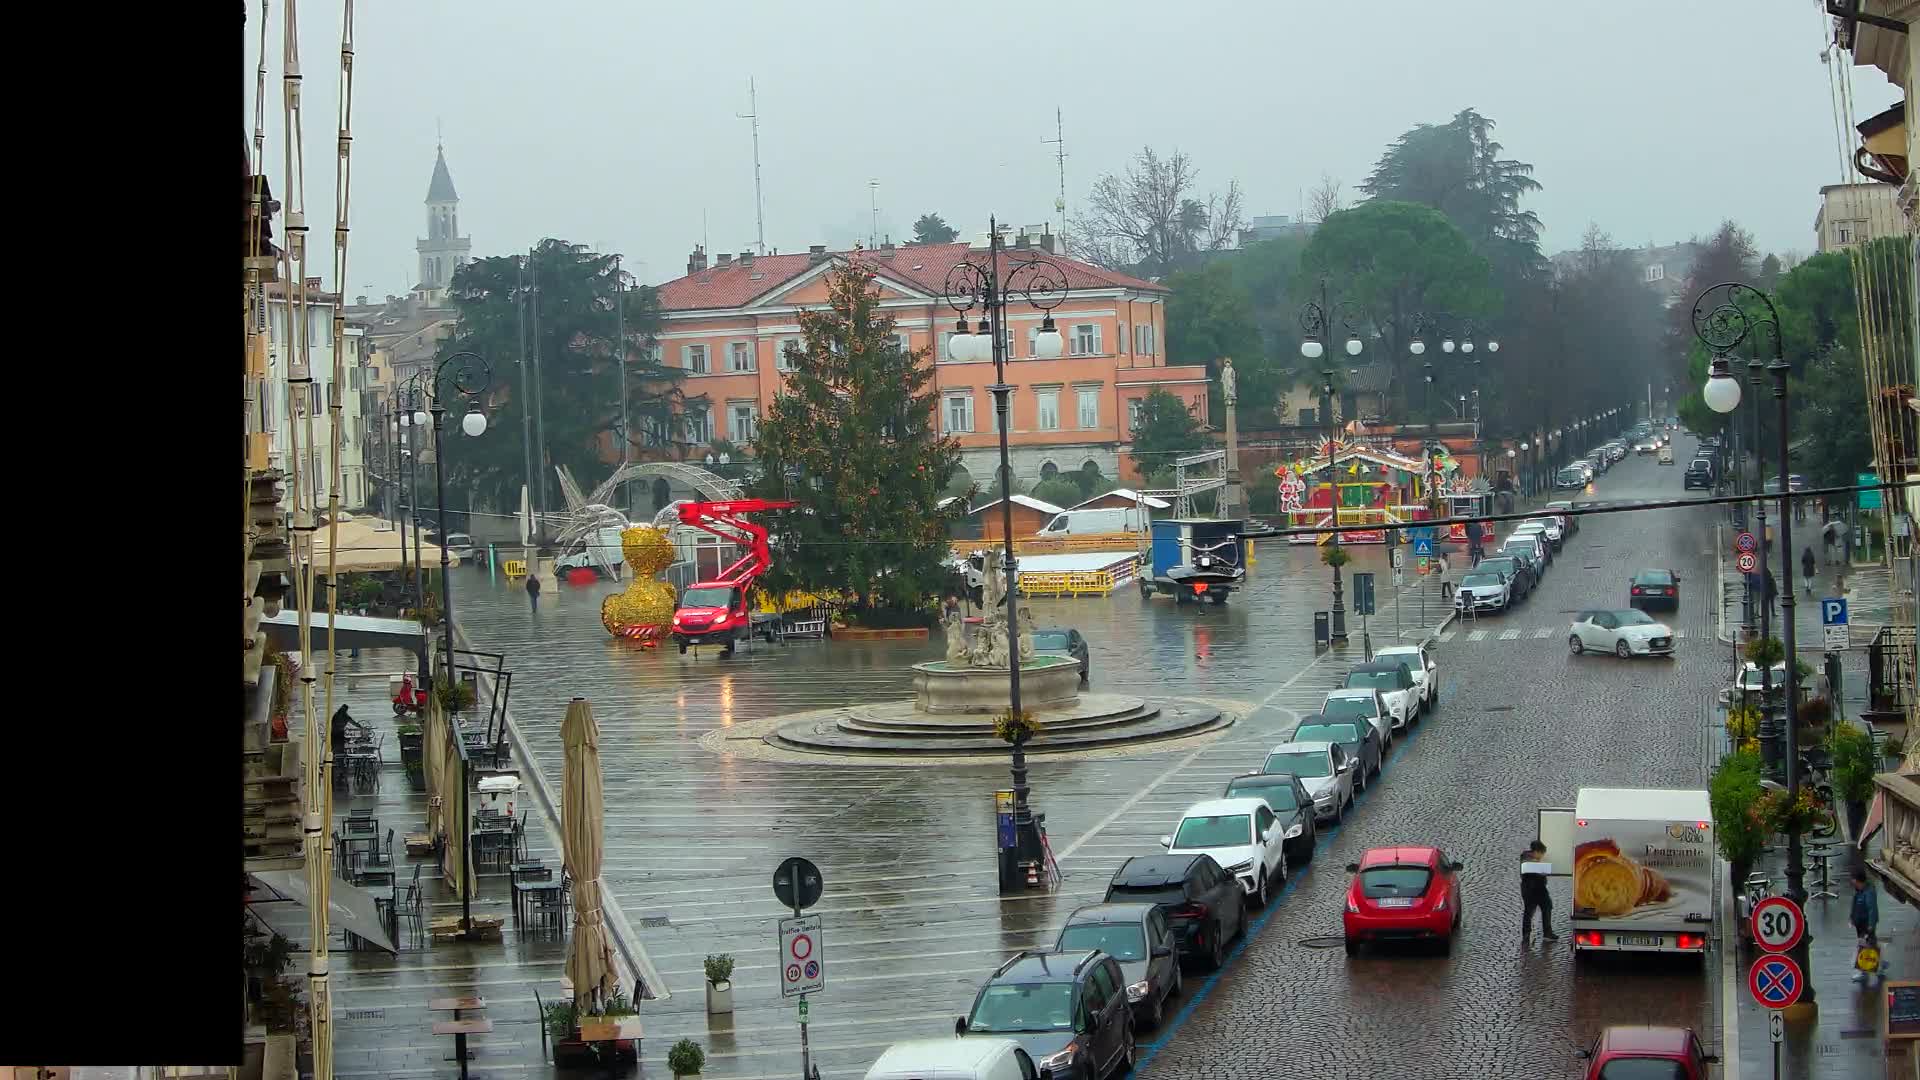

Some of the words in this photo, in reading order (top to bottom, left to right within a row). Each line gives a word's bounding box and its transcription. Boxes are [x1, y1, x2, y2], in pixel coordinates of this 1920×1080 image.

[1742, 557, 1753, 567] 20
[1827, 602, 1842, 622] P
[1762, 911, 1792, 937] 30
[790, 969, 798, 978] 20
